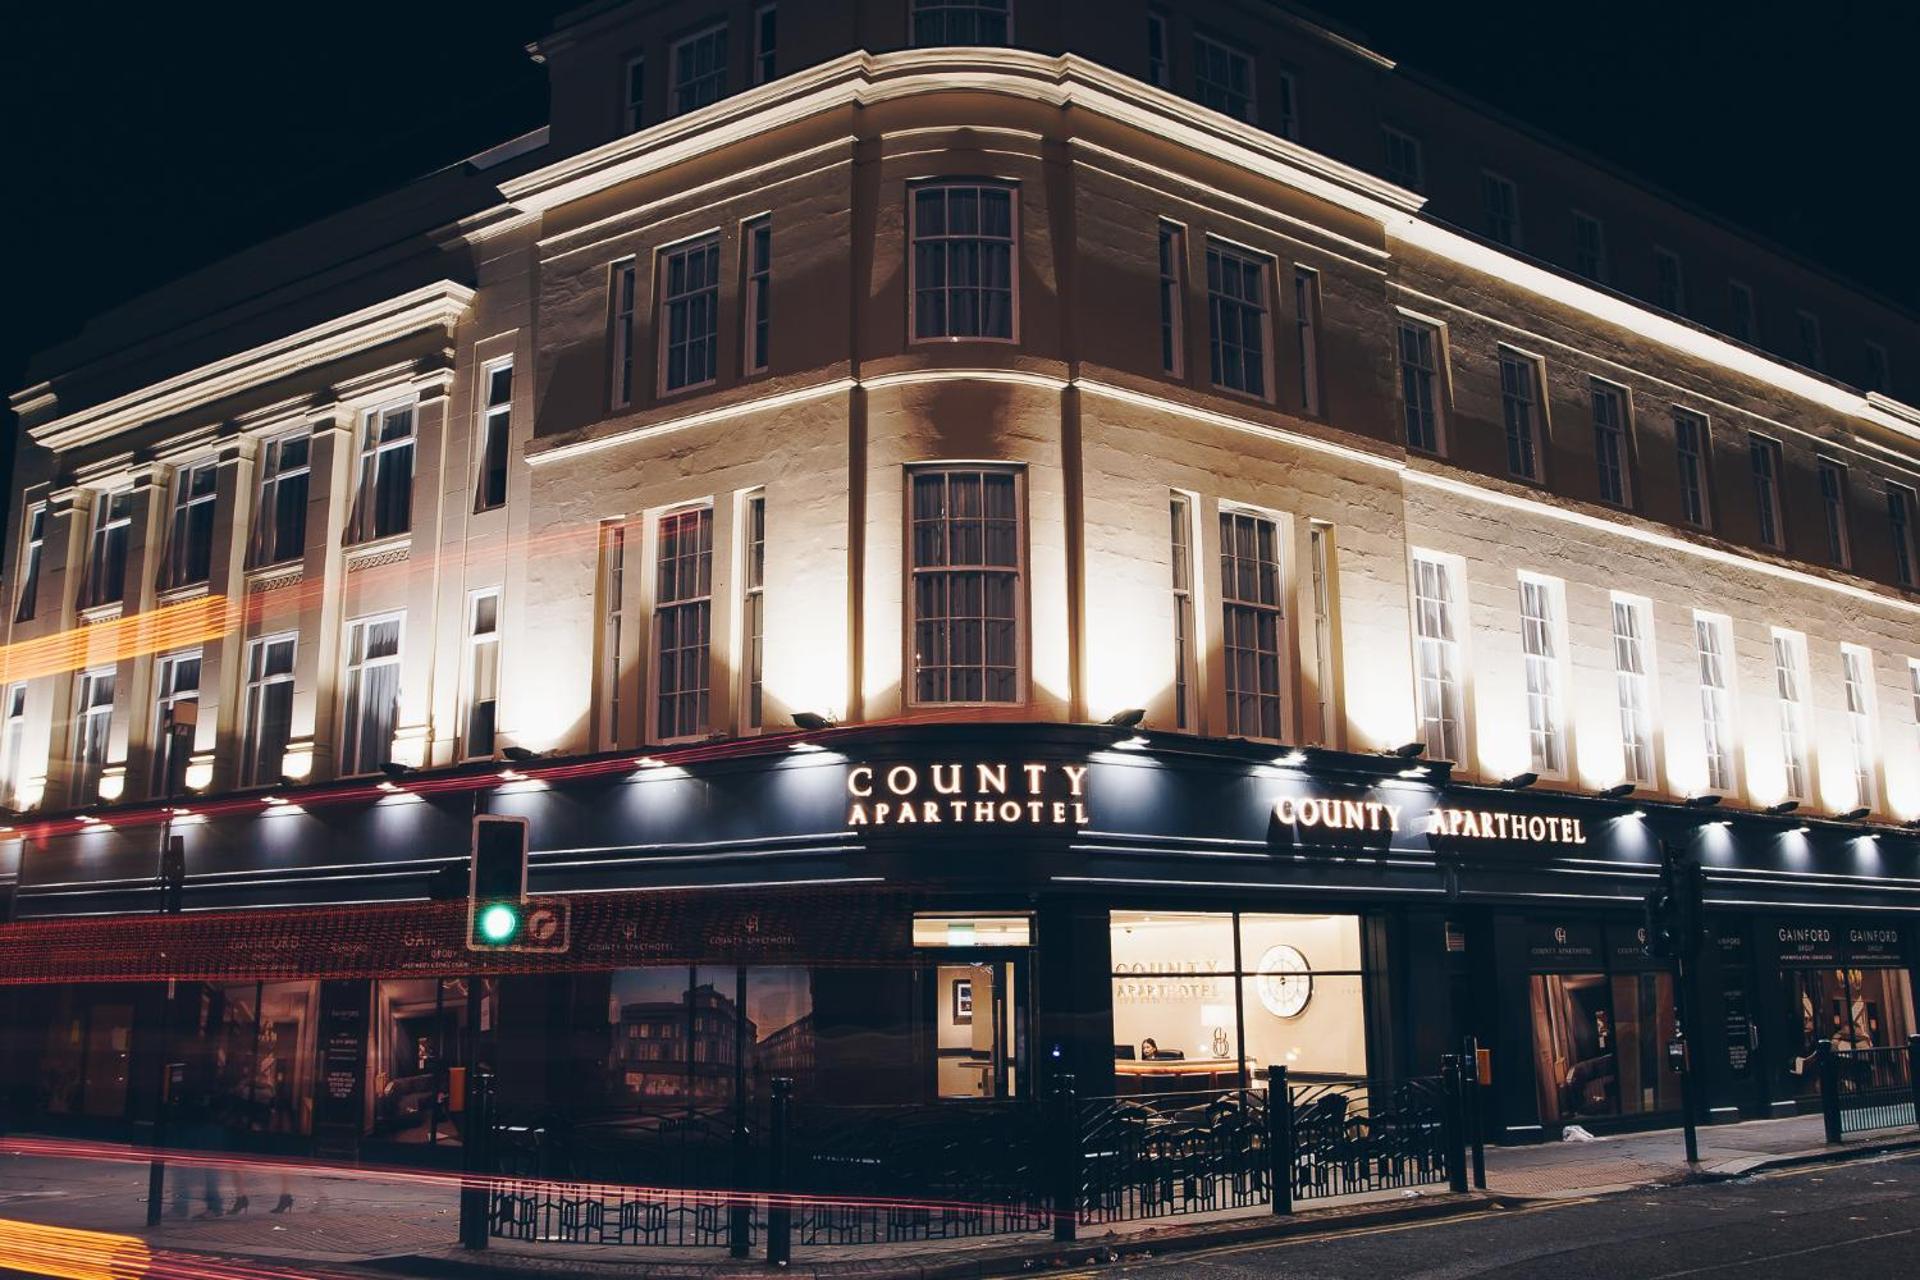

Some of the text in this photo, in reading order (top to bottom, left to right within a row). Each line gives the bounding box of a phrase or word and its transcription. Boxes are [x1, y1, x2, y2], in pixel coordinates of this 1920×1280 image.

[848, 764, 1089, 797] COUNTY
[848, 801, 1090, 825] APARTHOTEL
[1273, 796, 1588, 845] COUNTY APARTHOTEL
[1778, 928, 1831, 942] GAINFORD
[1850, 929, 1899, 943] GAINFORD
